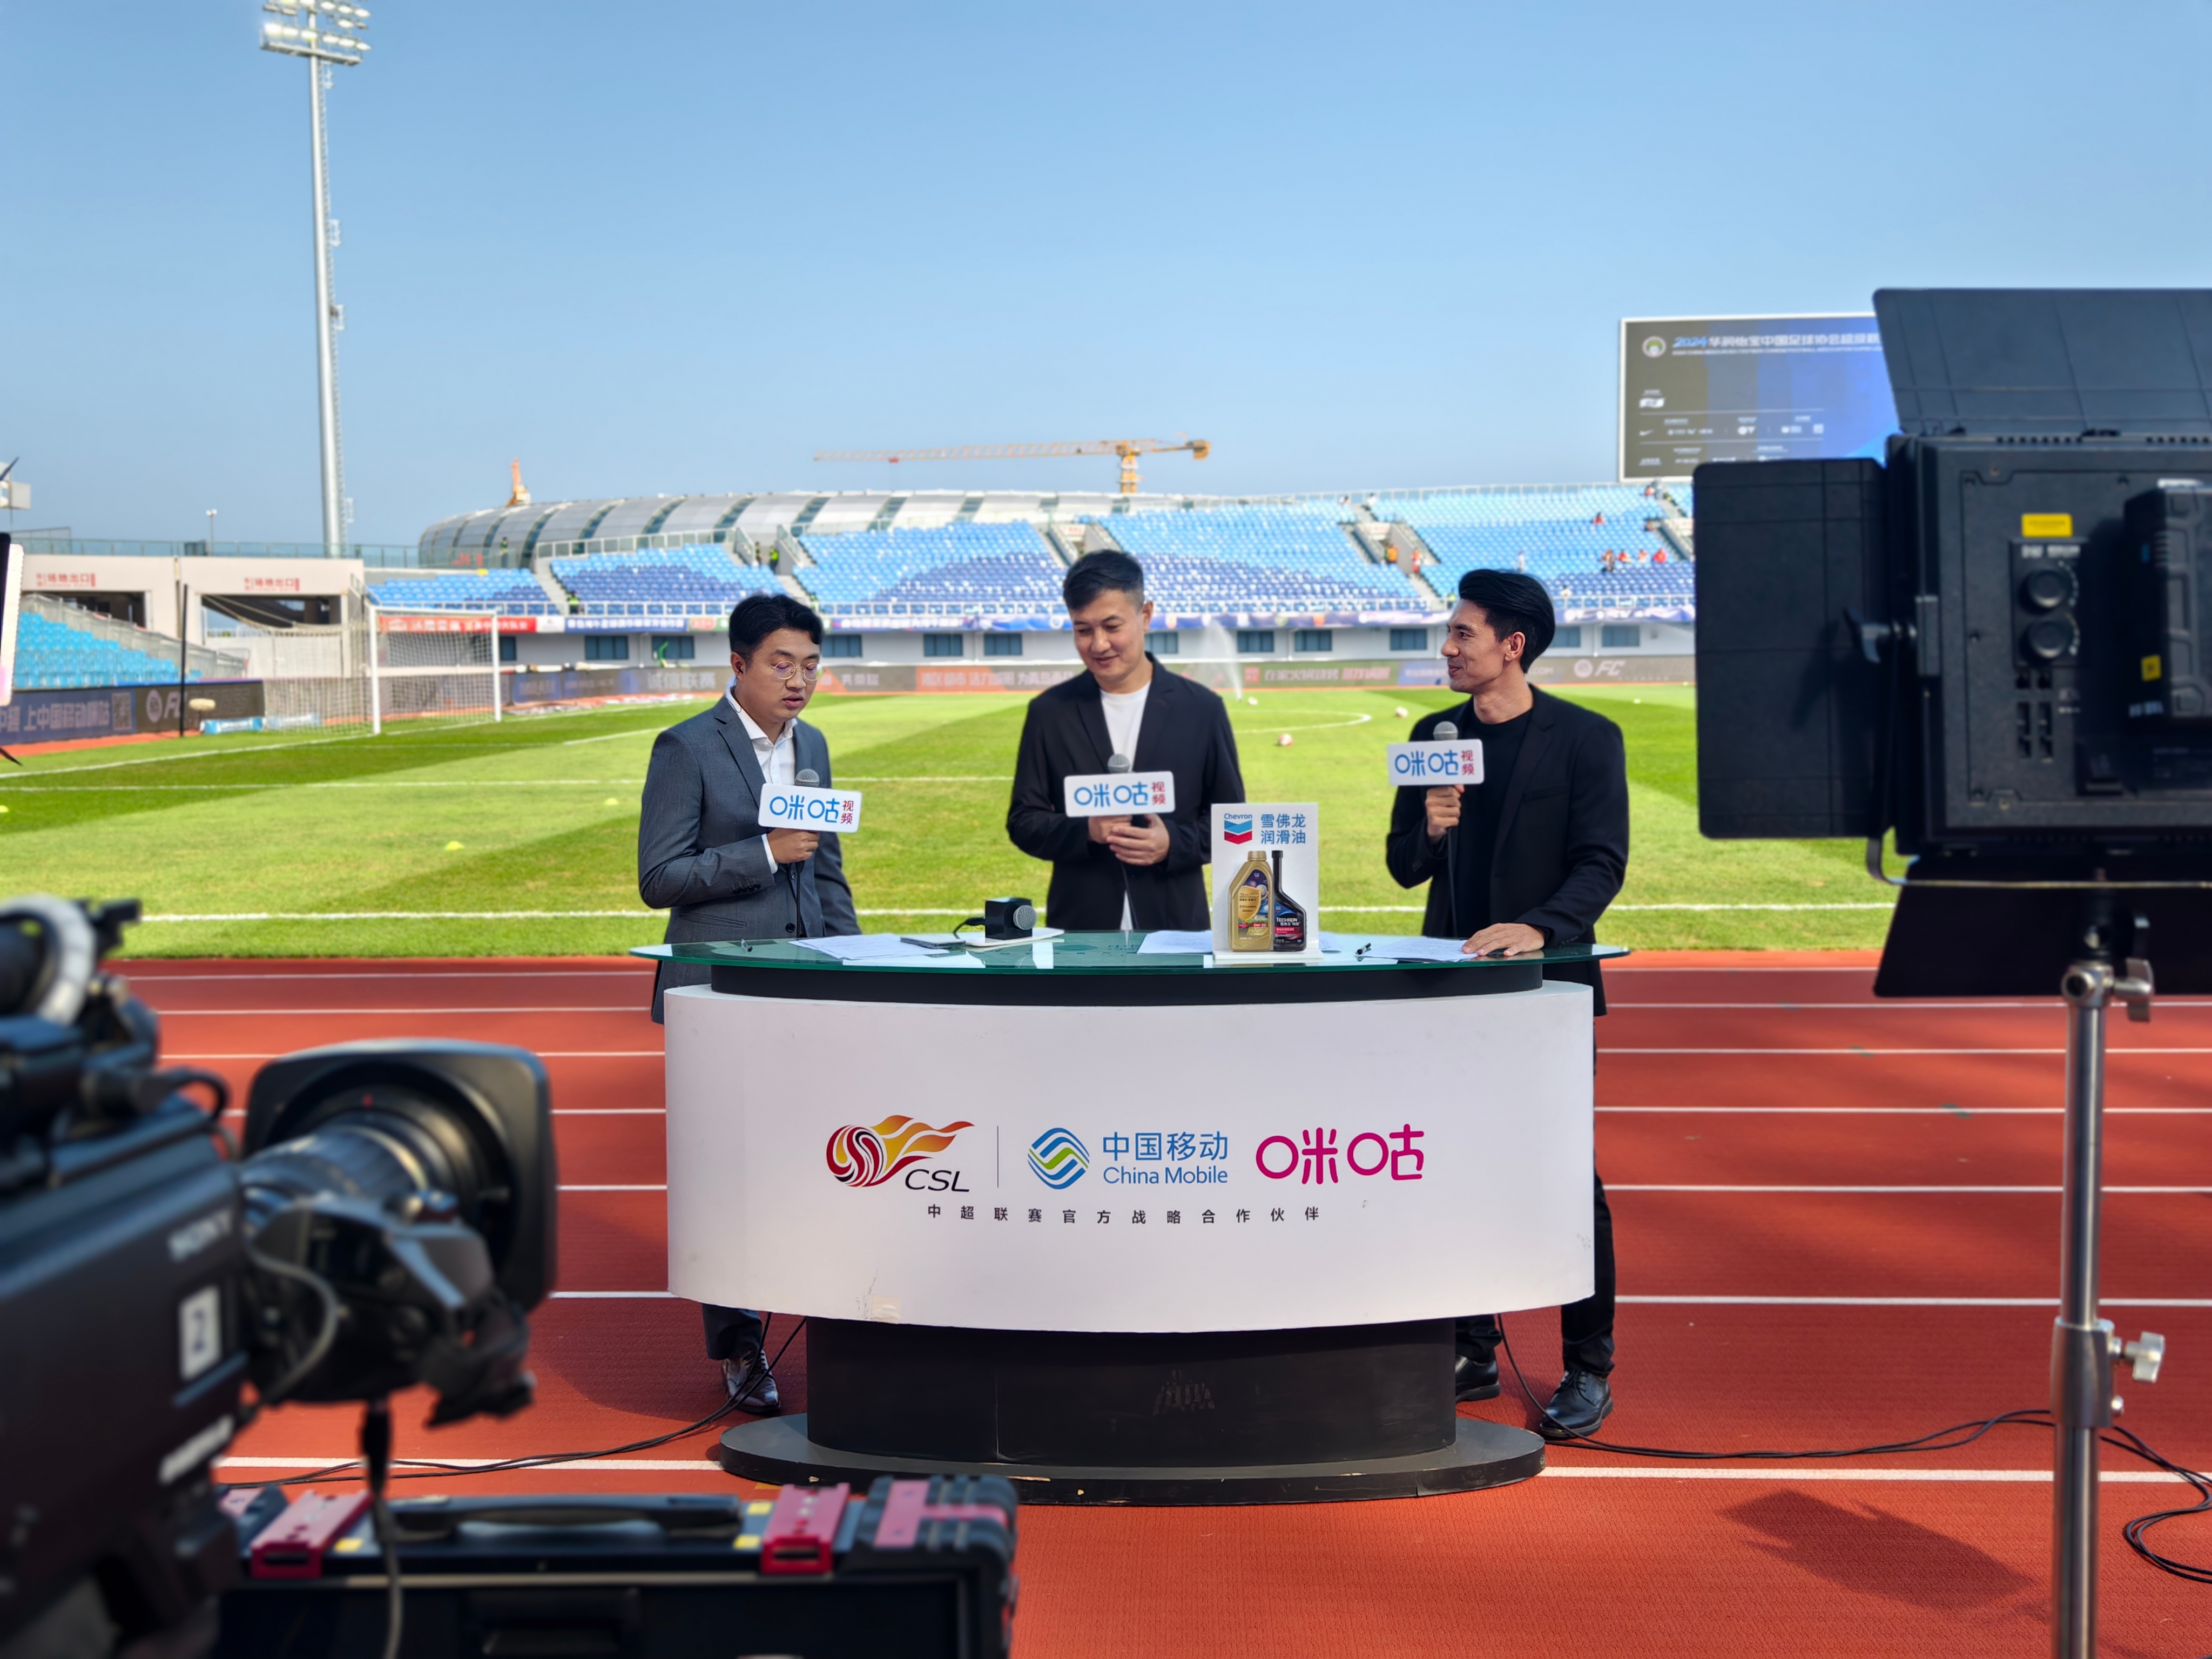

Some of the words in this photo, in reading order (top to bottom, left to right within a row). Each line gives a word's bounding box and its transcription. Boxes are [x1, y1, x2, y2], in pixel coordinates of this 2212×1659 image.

[1395, 749, 1458, 777] 咪咕
[1461, 750, 1474, 775] 视频
[1074, 781, 1148, 808] 咪咕
[1151, 781, 1166, 805] 视频
[770, 795, 840, 823] 咪咕
[840, 800, 854, 824] 视频
[1260, 813, 1306, 828] 雪佛龙
[1260, 830, 1306, 845] 润滑油
[1103, 1131, 1228, 1162] 中国移动
[1256, 1123, 1425, 1185] 咪咕
[905, 1169, 970, 1192] CSL
[1103, 1165, 1159, 1184] China
[1165, 1165, 1228, 1184] Mobile
[927, 1204, 1319, 1224] 中超联赛官方战略合作伙伴
